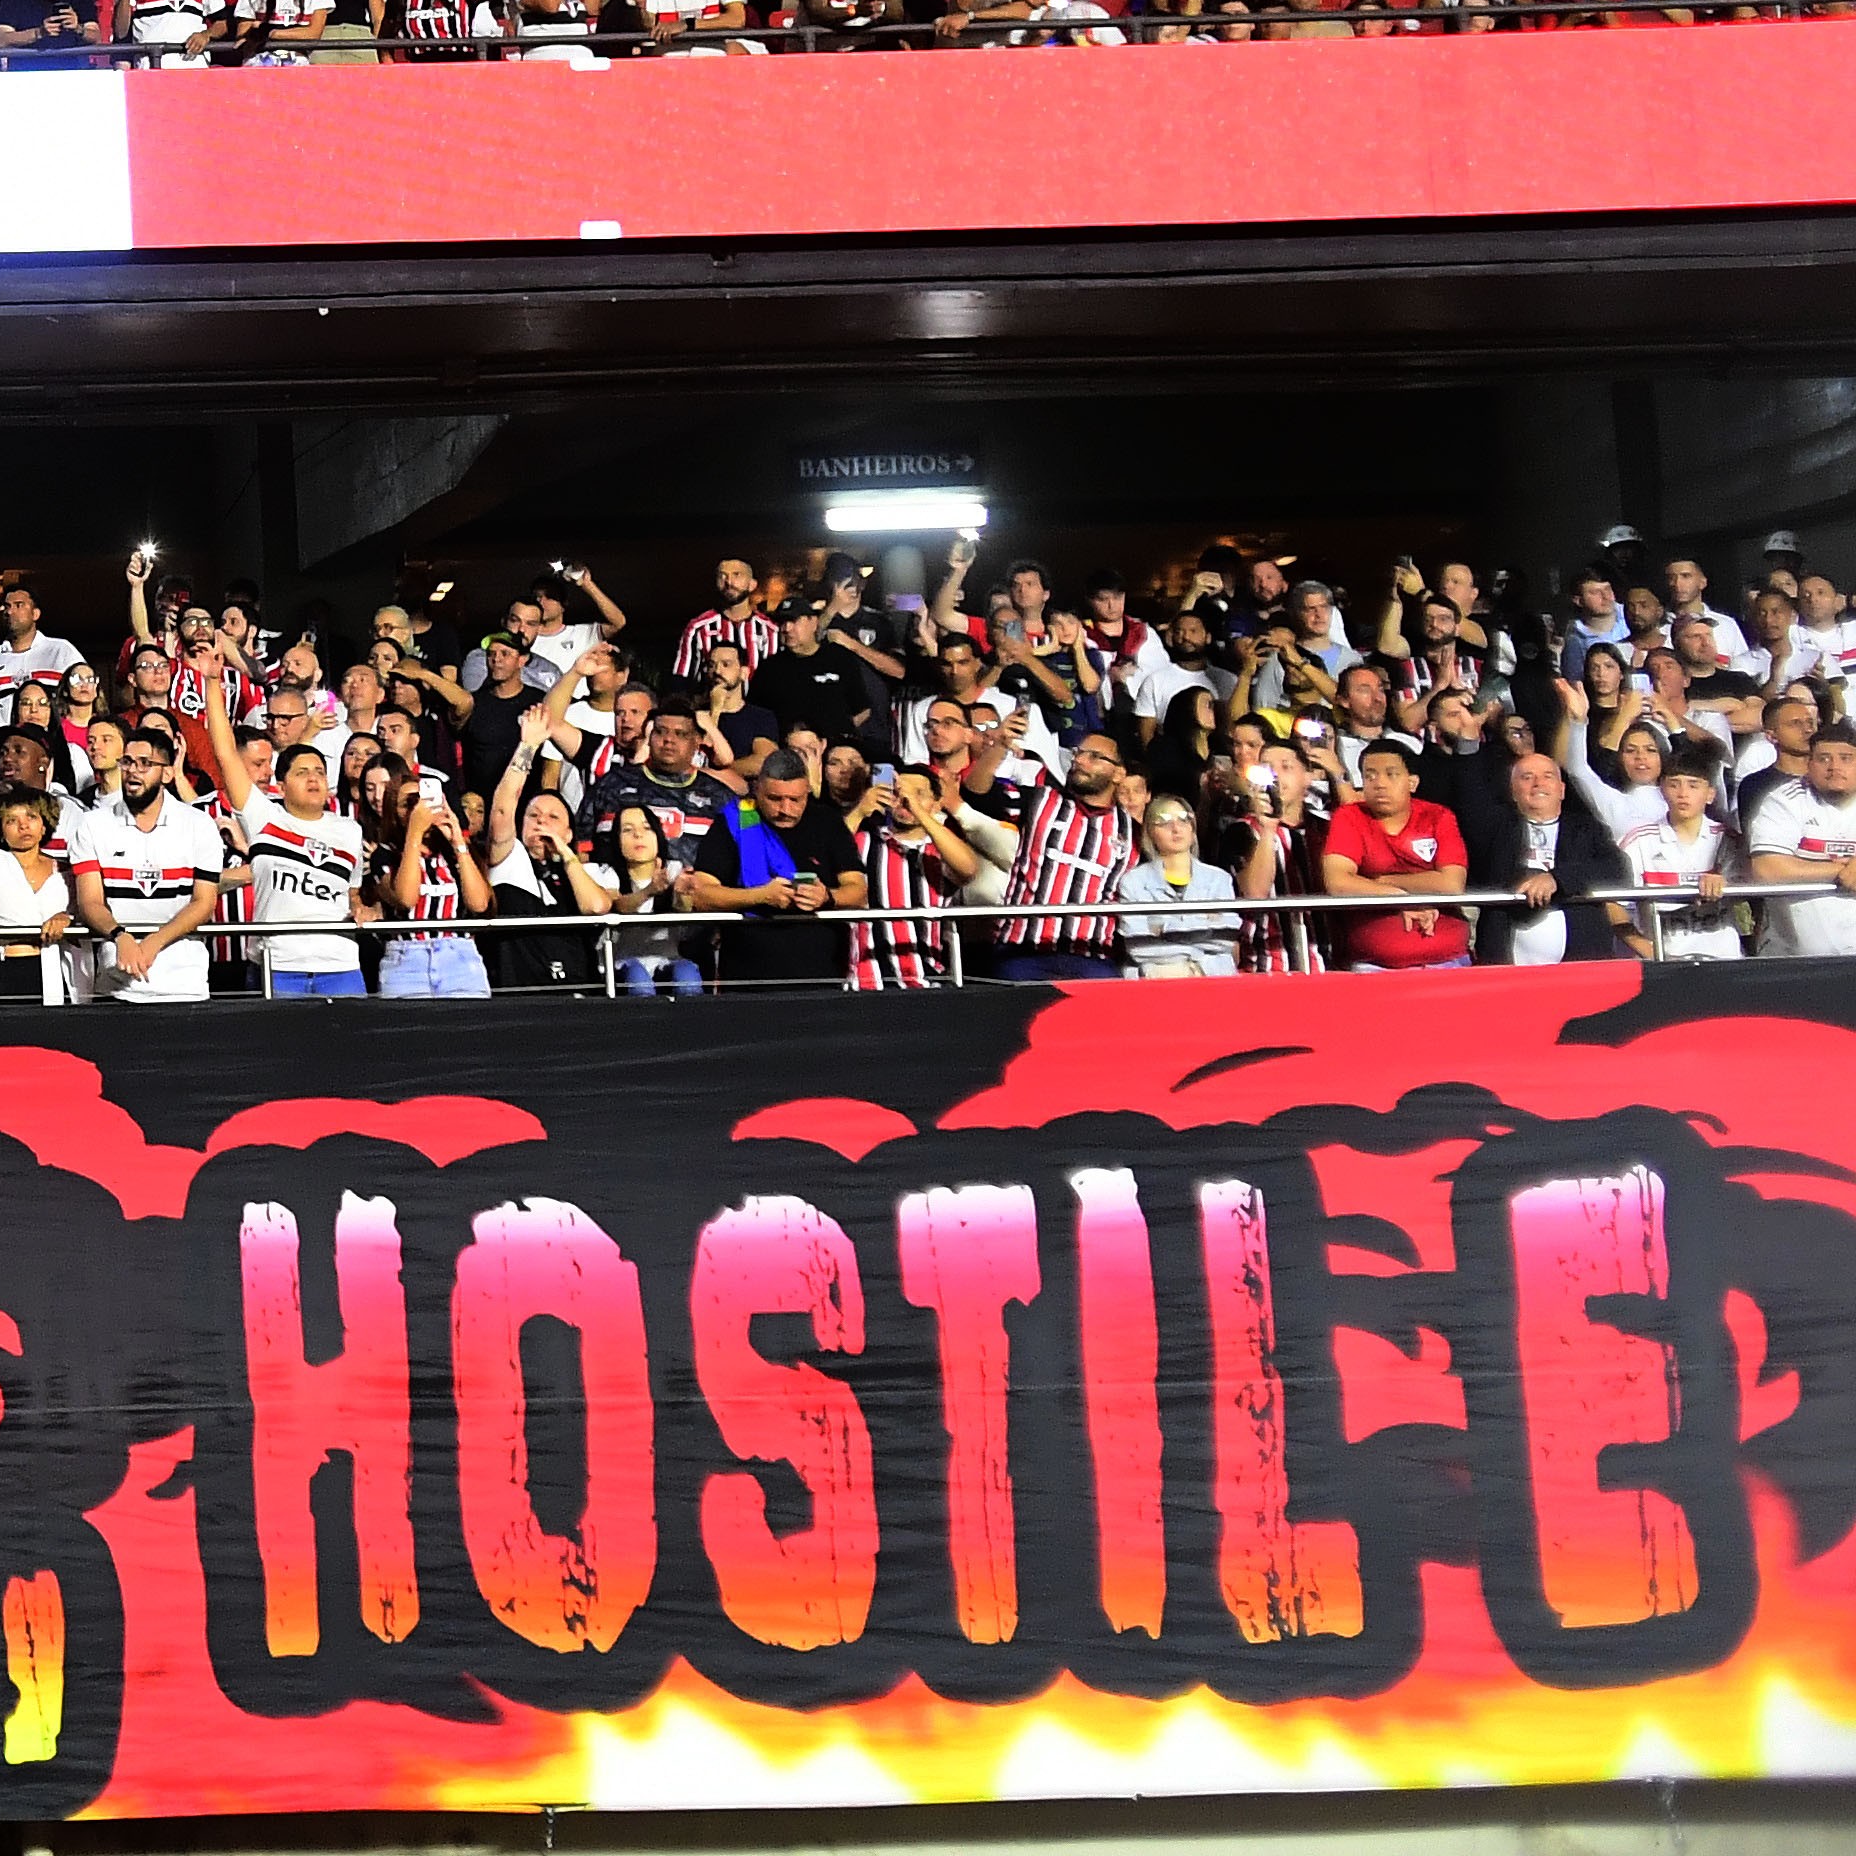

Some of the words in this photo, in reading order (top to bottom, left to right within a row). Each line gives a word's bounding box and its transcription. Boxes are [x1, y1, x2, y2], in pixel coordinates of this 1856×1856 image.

[798, 453, 952, 478] BANHEIROS
[272, 869, 343, 902] inter
[237, 1166, 1701, 1657] HOSTILE
